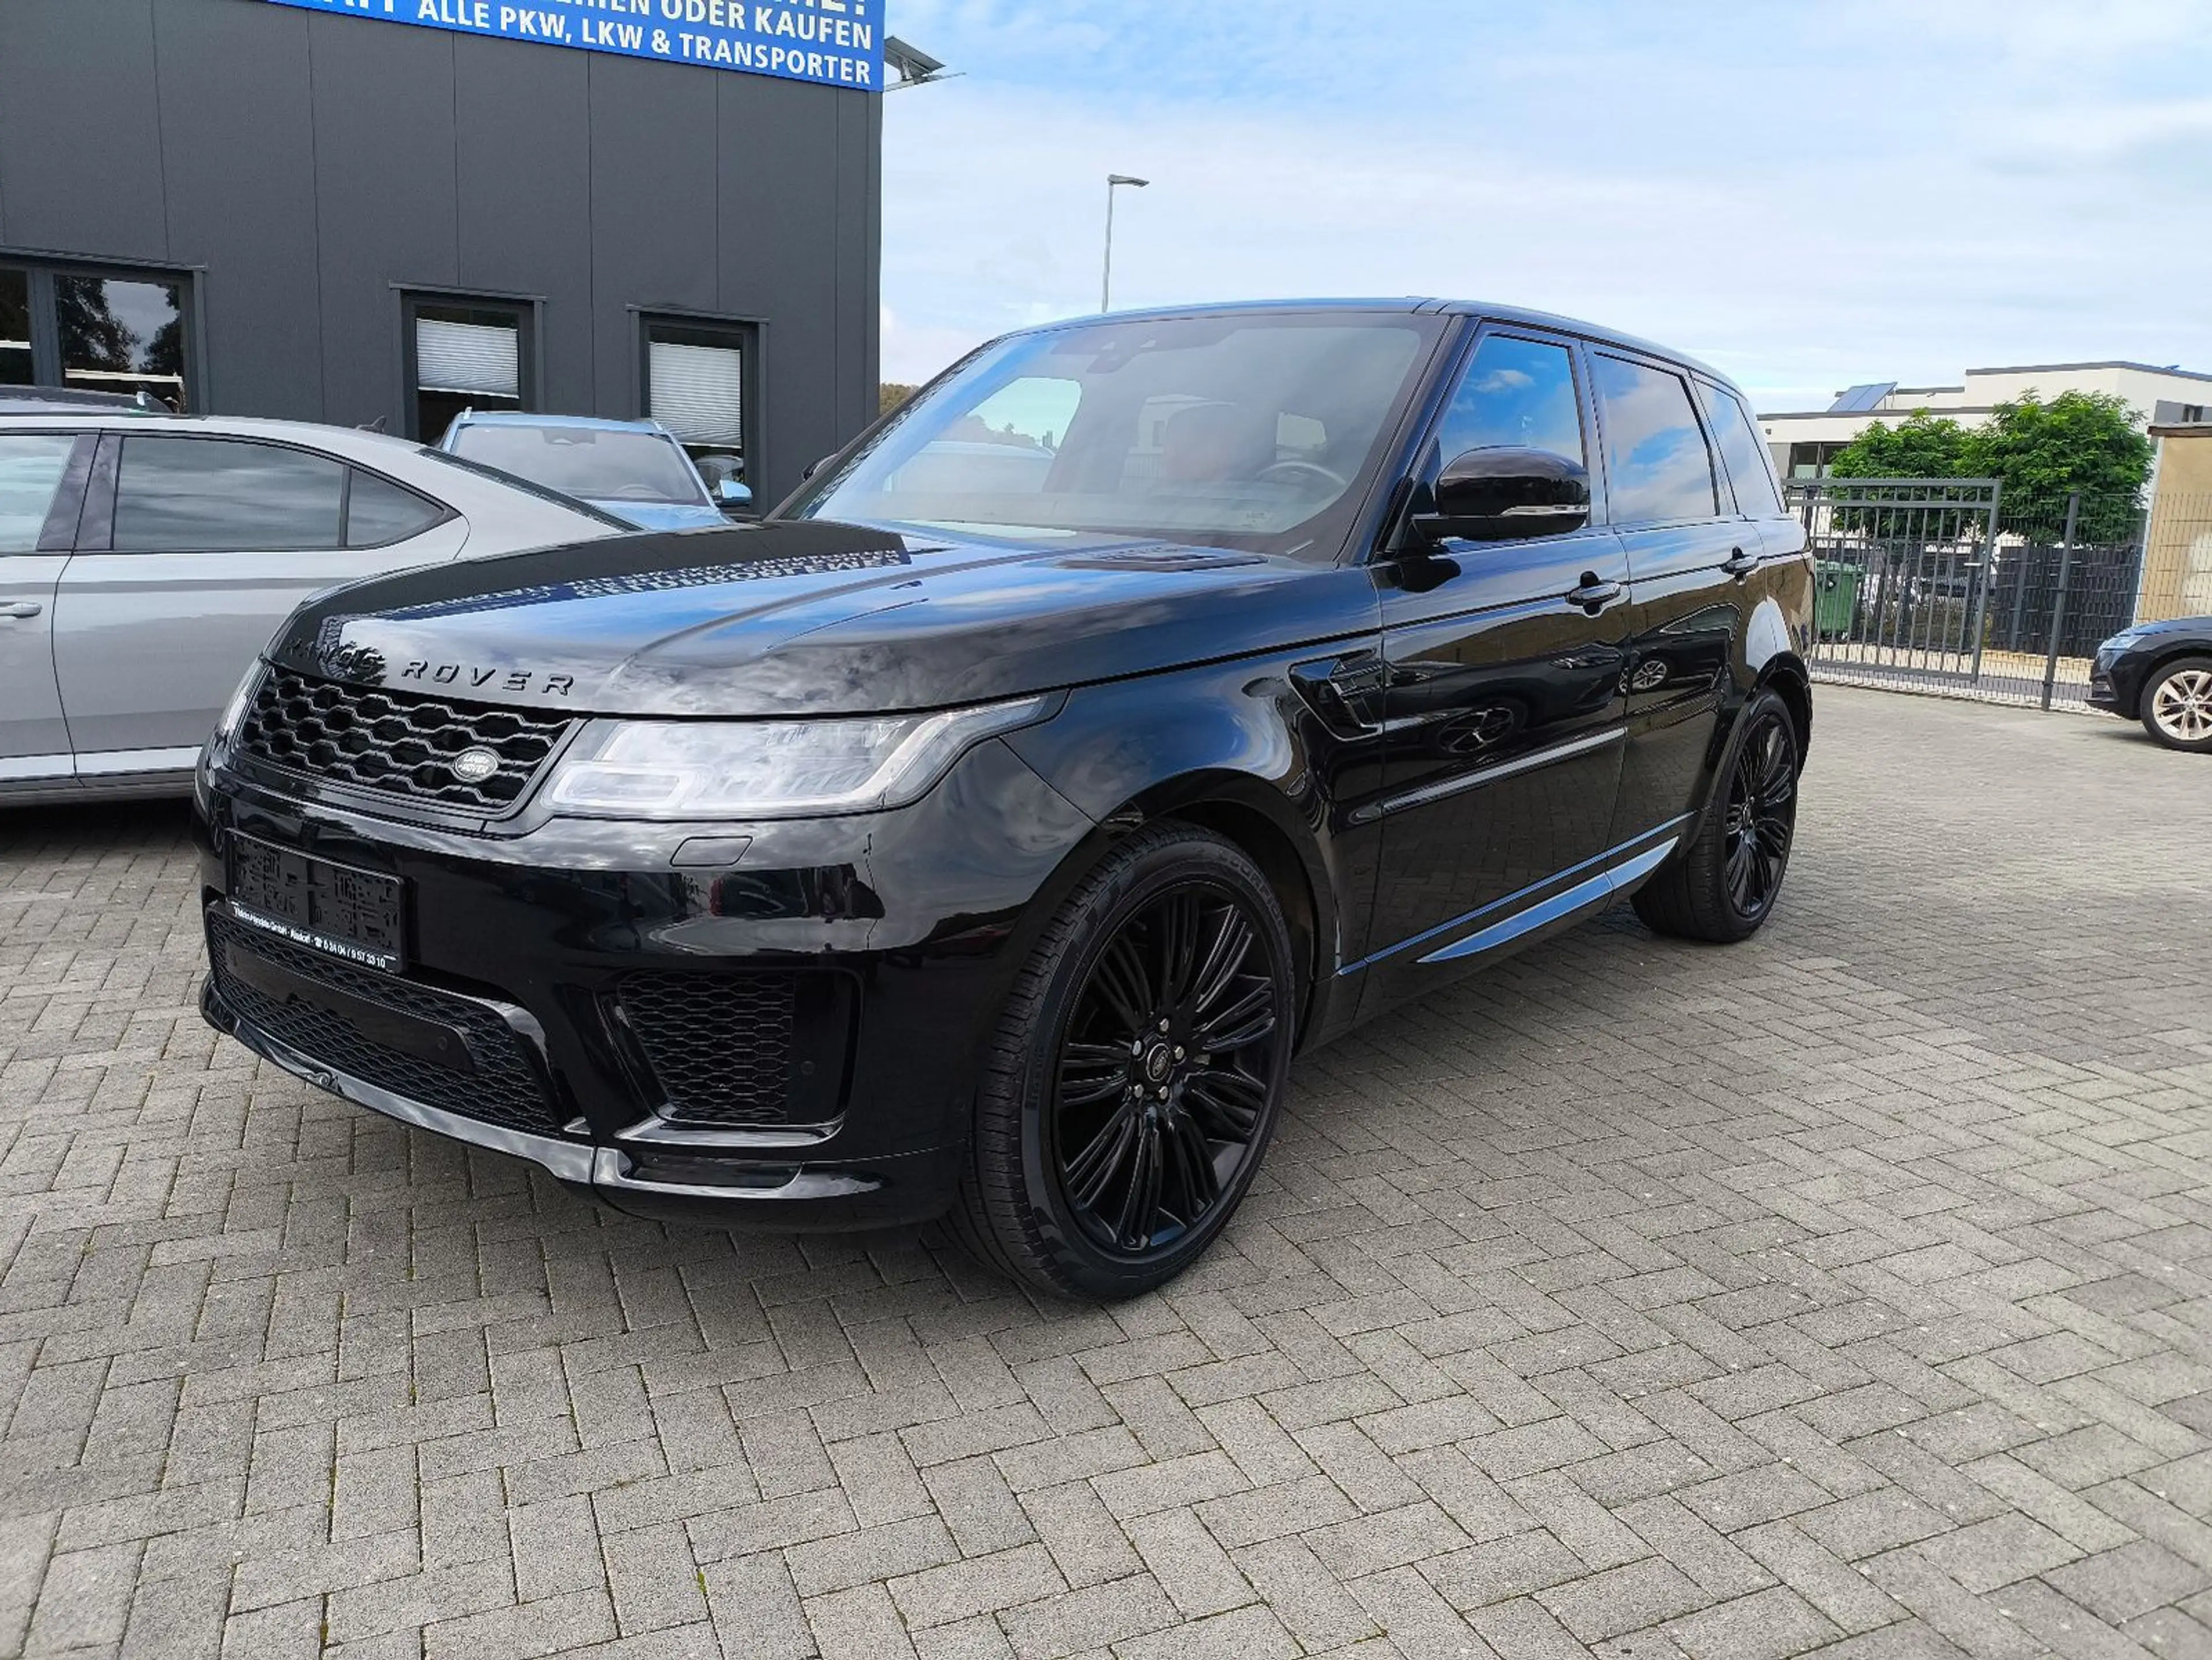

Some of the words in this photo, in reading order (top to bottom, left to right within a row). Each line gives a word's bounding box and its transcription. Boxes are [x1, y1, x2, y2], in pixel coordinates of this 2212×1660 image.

[418, 0, 490, 28] ALLE
[500, 5, 572, 43] PKW,
[582, 18, 643, 50] LKW
[651, 28, 672, 55] &
[679, 32, 871, 85] TRANSPORTER
[661, 0, 745, 30] ODER
[755, 6, 872, 50] KAUFEN
[402, 660, 575, 696] ROVER
[376, 957, 386, 968] 10
